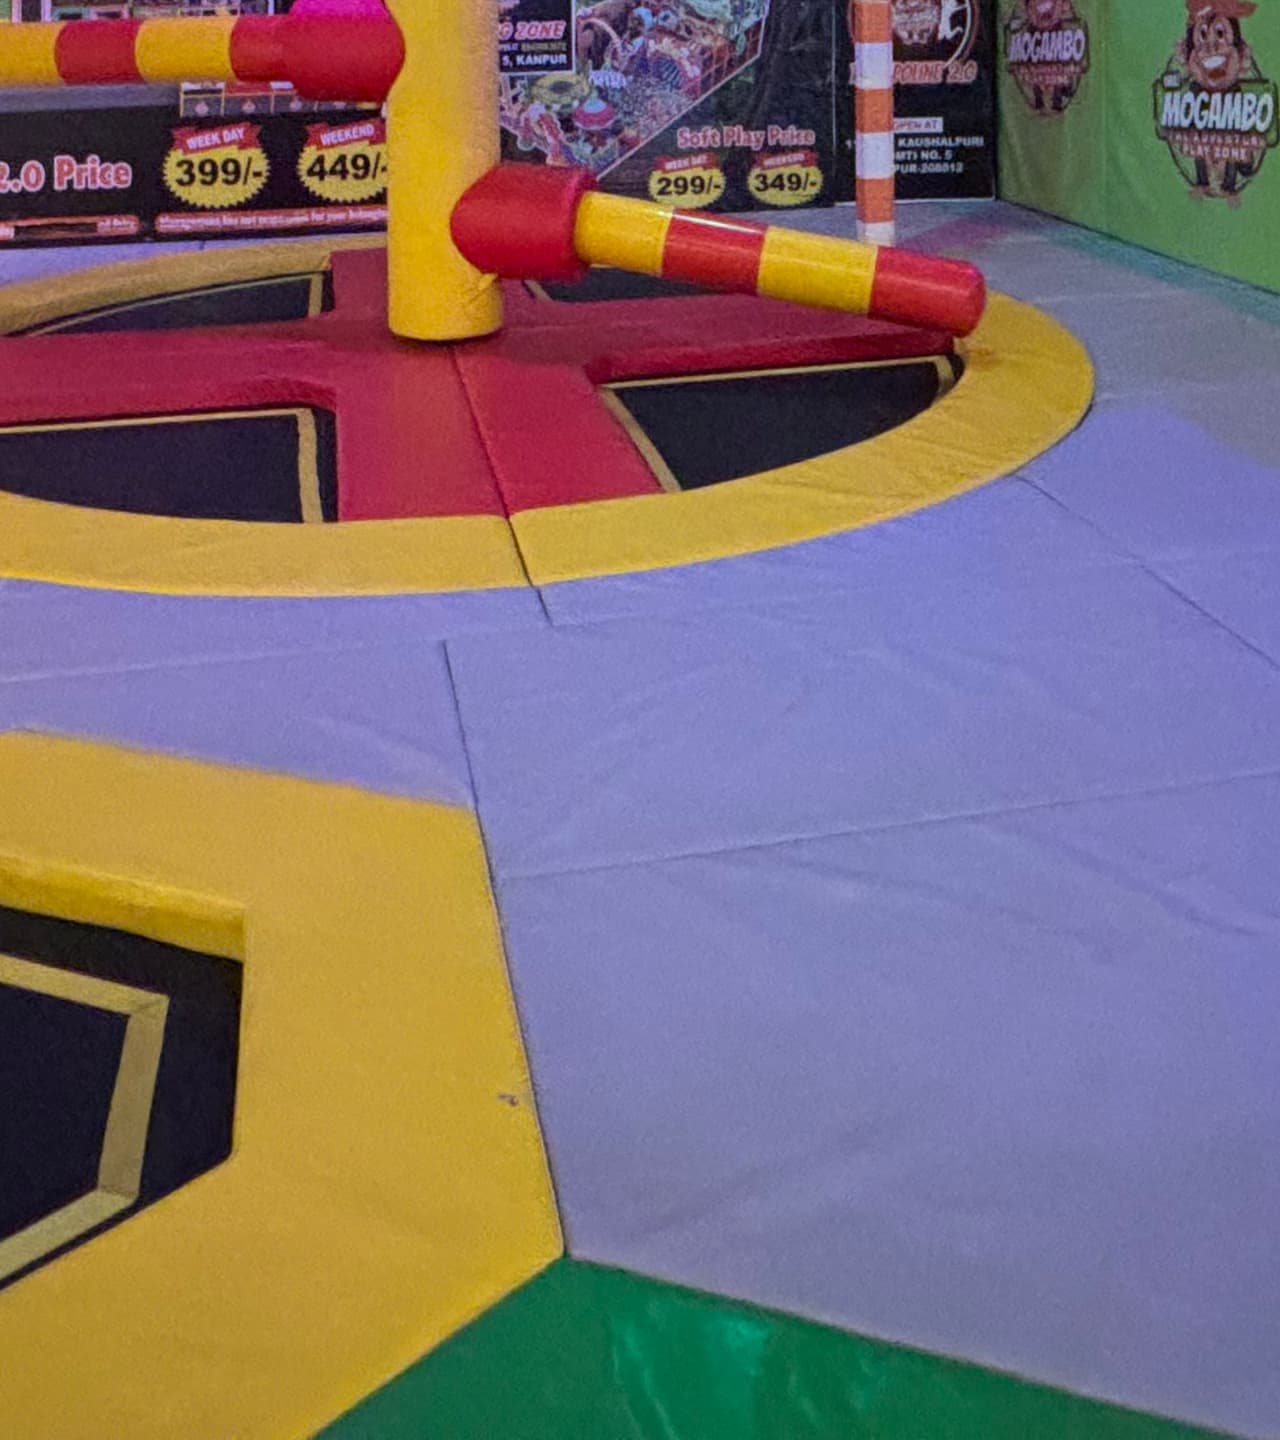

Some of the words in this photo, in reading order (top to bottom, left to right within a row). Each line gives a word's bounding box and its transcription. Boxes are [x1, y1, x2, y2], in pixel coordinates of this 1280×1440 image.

[514, 21, 566, 40] ZONE
[1007, 29, 1086, 62] MOGAMBO
[516, 54, 568, 65] KANPUR
[1161, 91, 1274, 132] MOGAMBO
[320, 124, 375, 146] WEEKEND
[924, 119, 938, 129] AT
[187, 134, 220, 150] WEEK
[223, 127, 245, 142] DAY
[677, 126, 720, 148] Soft
[723, 125, 765, 150] Play
[768, 124, 816, 146] Price
[53, 155, 133, 190] Price
[175, 157, 262, 187] 399/-
[306, 152, 388, 182] 449/-
[657, 176, 720, 196] 299/-
[754, 172, 817, 192] 349/-
